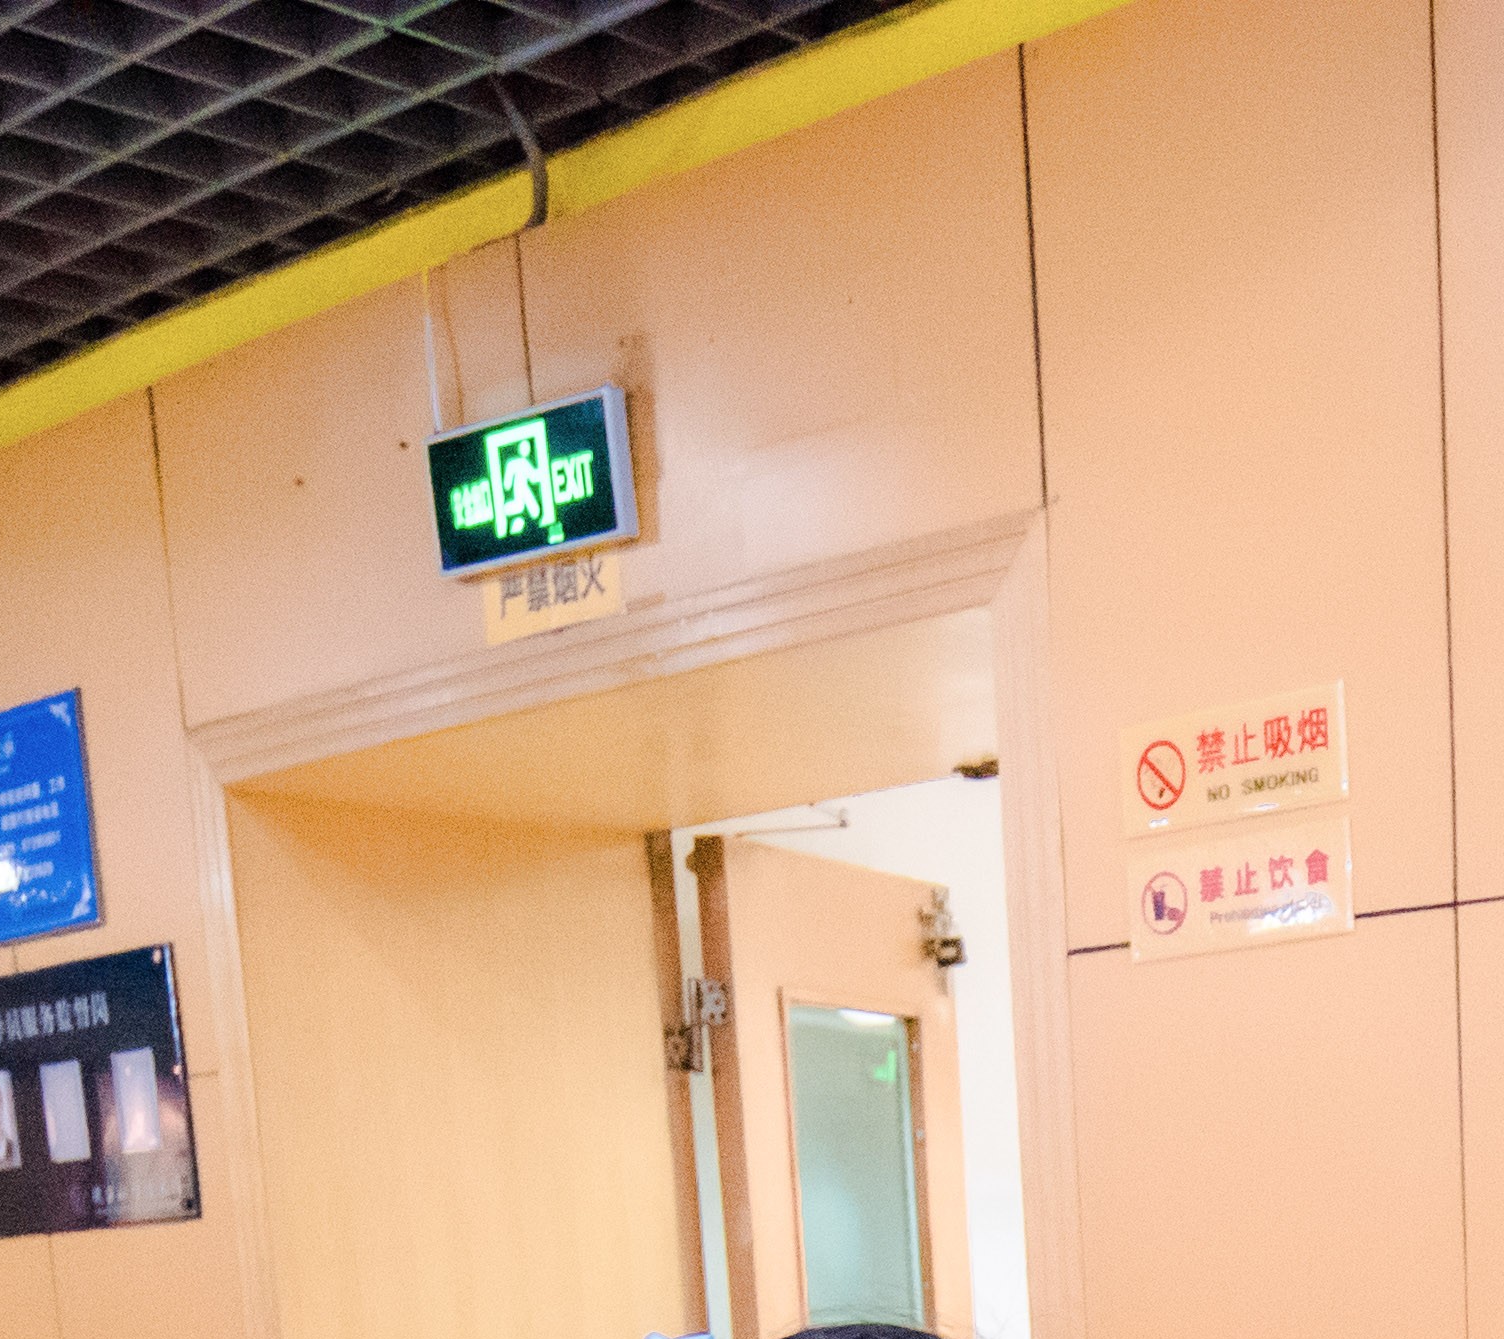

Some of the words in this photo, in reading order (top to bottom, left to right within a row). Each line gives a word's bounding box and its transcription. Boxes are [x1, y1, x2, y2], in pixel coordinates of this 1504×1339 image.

[551, 450, 595, 505] EXIT
[1195, 706, 1330, 775] 禁止吸烟
[1206, 783, 1231, 803] NO
[1240, 767, 1320, 797] SMOKING
[1199, 848, 1330, 904] 禁止饮食
